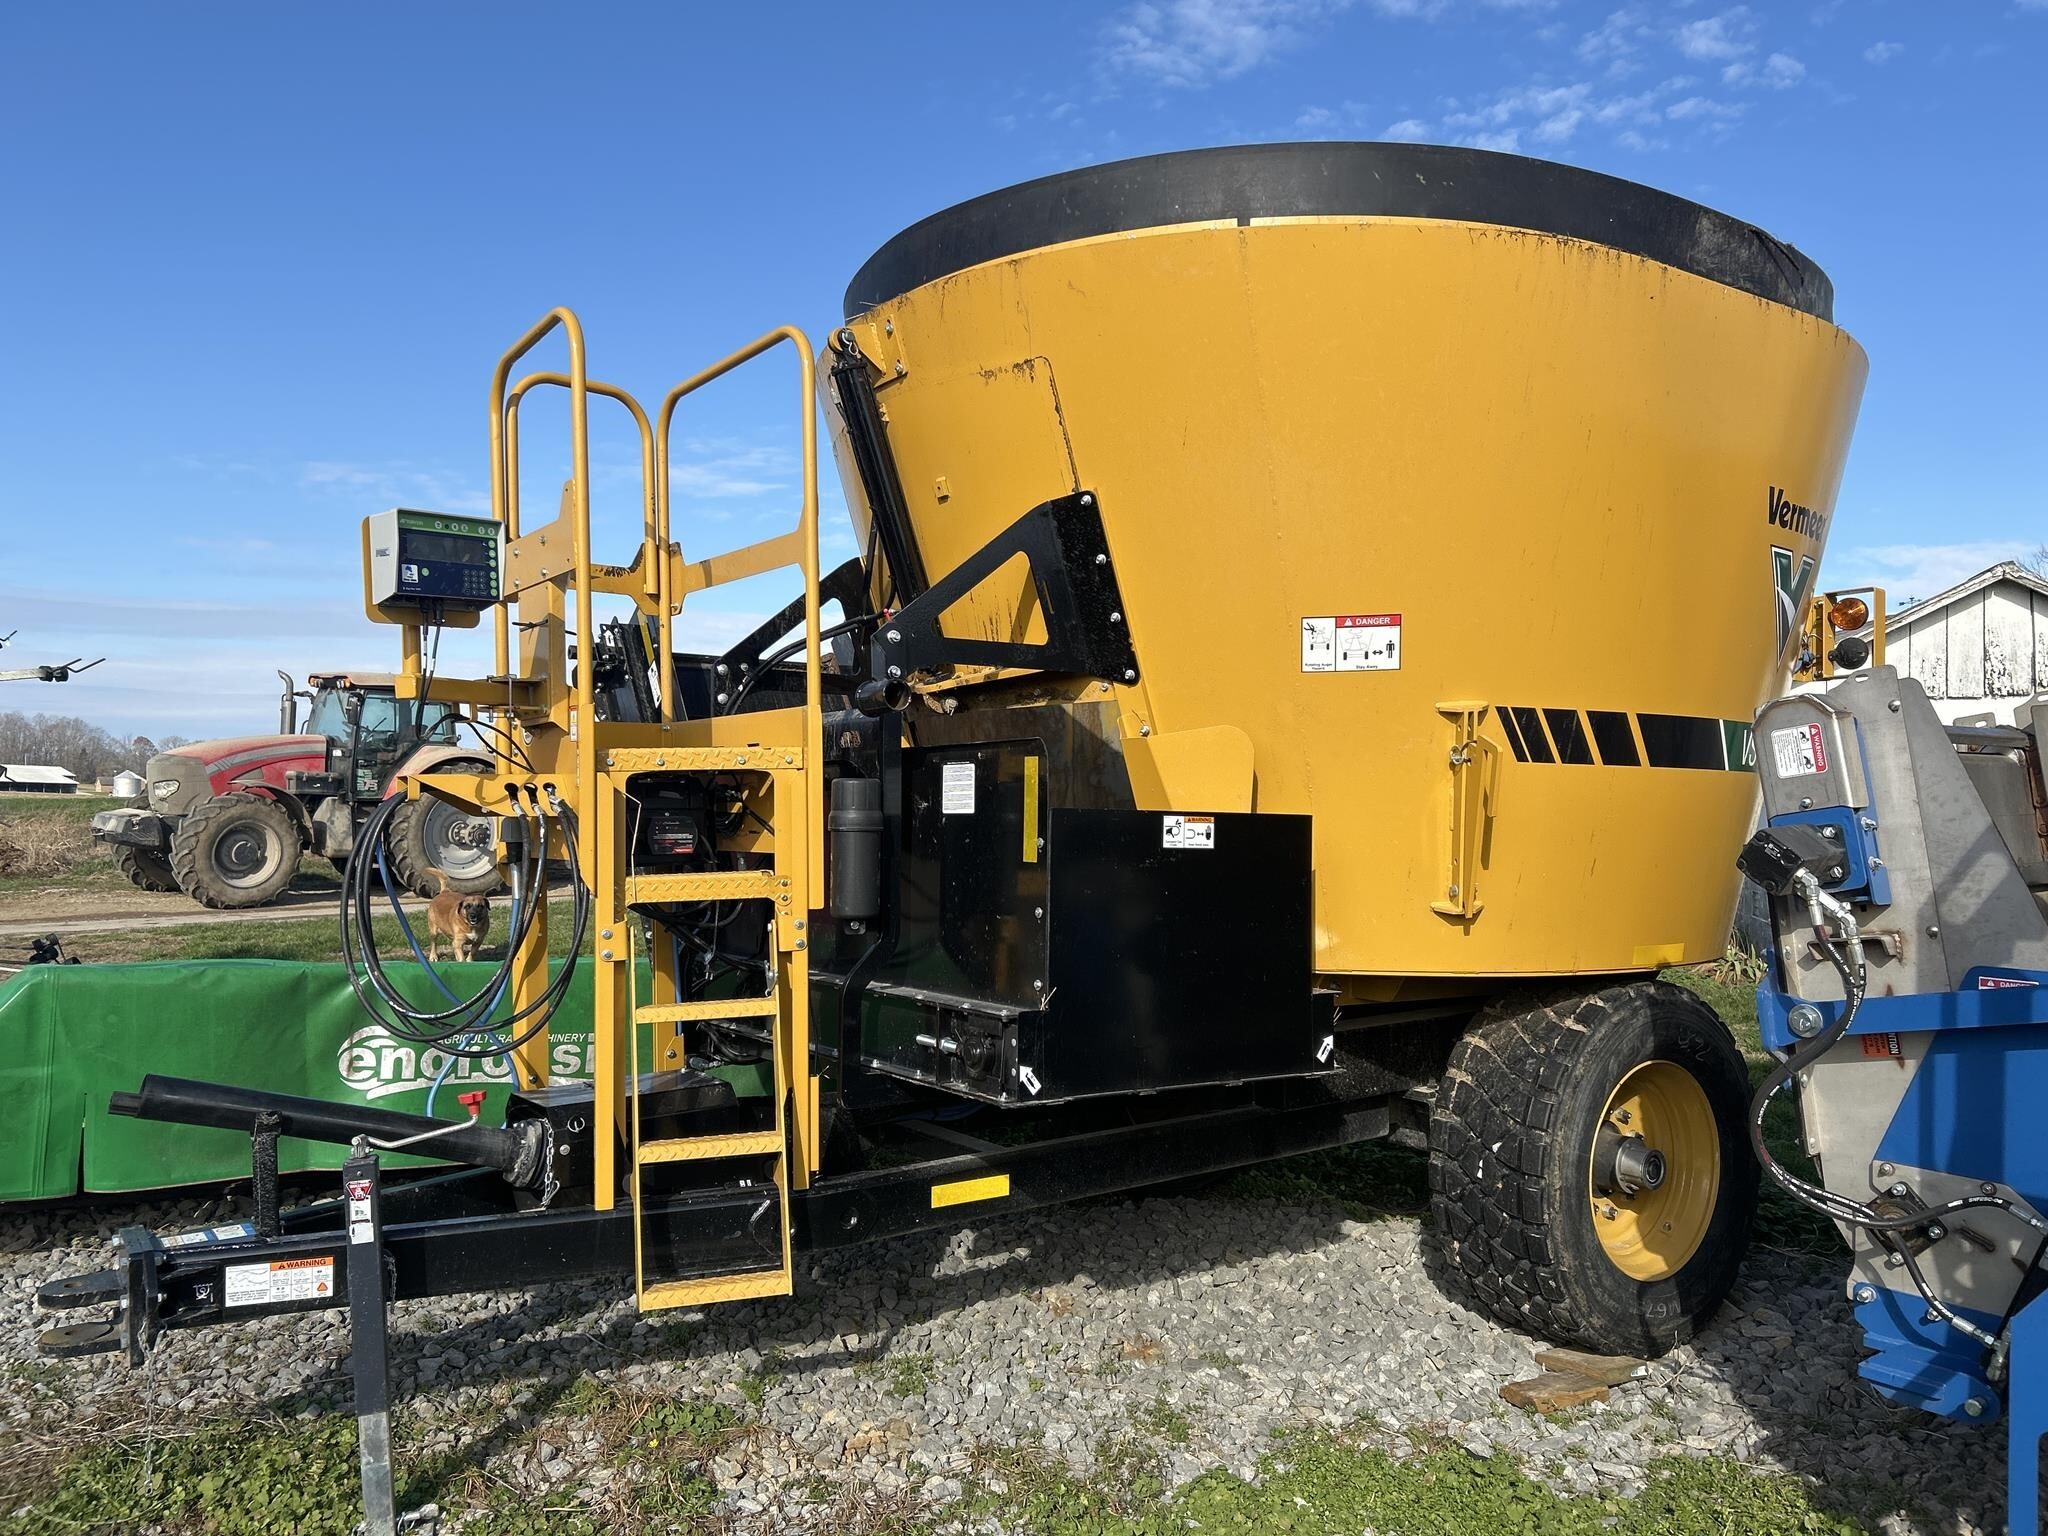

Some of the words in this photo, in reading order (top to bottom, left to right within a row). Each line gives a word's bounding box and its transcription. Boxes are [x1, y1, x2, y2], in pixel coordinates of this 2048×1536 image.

[1355, 617, 1391, 625] DANGER
[1813, 735, 1825, 767] WARNING
[547, 1033, 586, 1043] HINERY
[1887, 1032, 1900, 1055] NTION
[286, 1258, 327, 1268] WARNING
